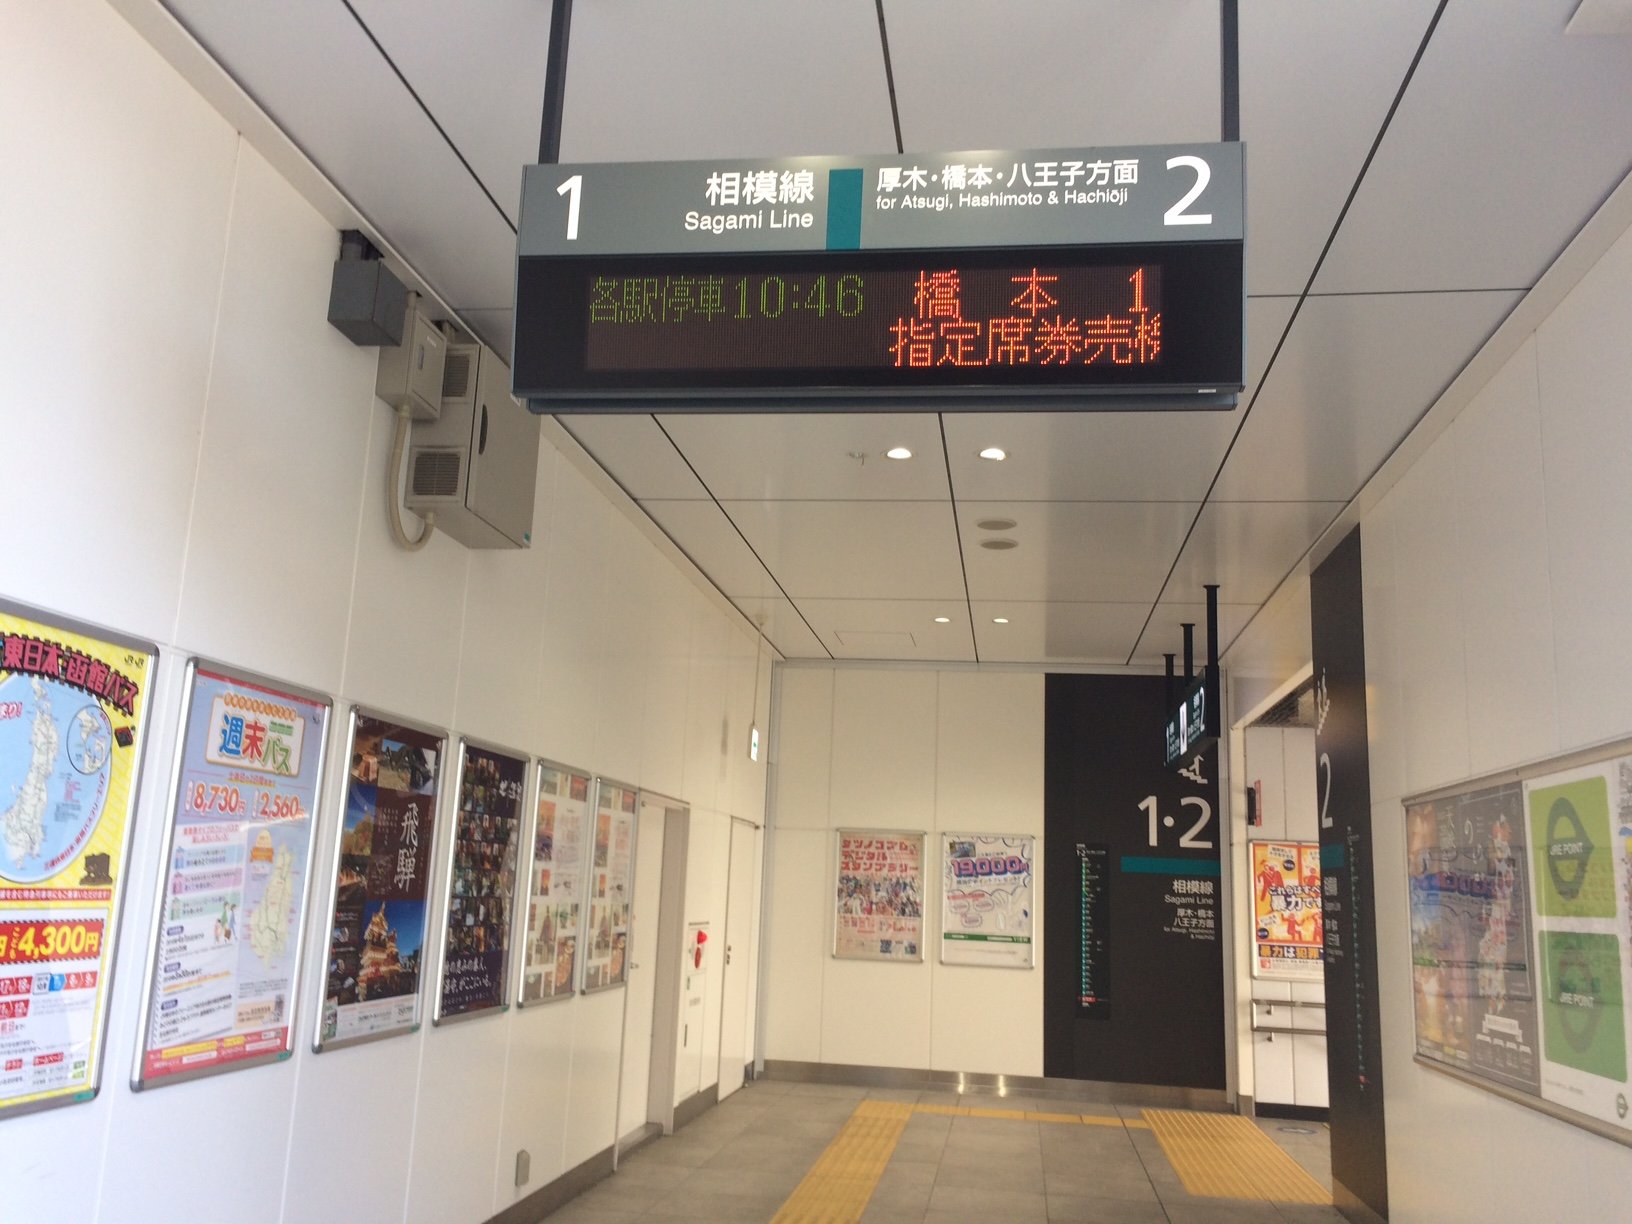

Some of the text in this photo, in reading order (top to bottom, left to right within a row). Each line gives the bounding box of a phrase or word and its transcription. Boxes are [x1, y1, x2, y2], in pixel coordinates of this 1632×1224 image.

[705, 169, 815, 207] 相模線
[876, 159, 1140, 193] 厚木・橋本・八王子方面
[1163, 155, 1213, 226] 2
[556, 175, 583, 241] 1
[876, 188, 1129, 212] for Atsugi, Hashimoto & Hachiōji
[684, 209, 814, 235] Sagami Line
[590, 274, 864, 323] 各駅停車 10:46
[218, 713, 291, 773] 週末パス
[1319, 752, 1334, 829] 2
[1172, 879, 1214, 895] 相模線
[18, 925, 100, 960] 4,300円
